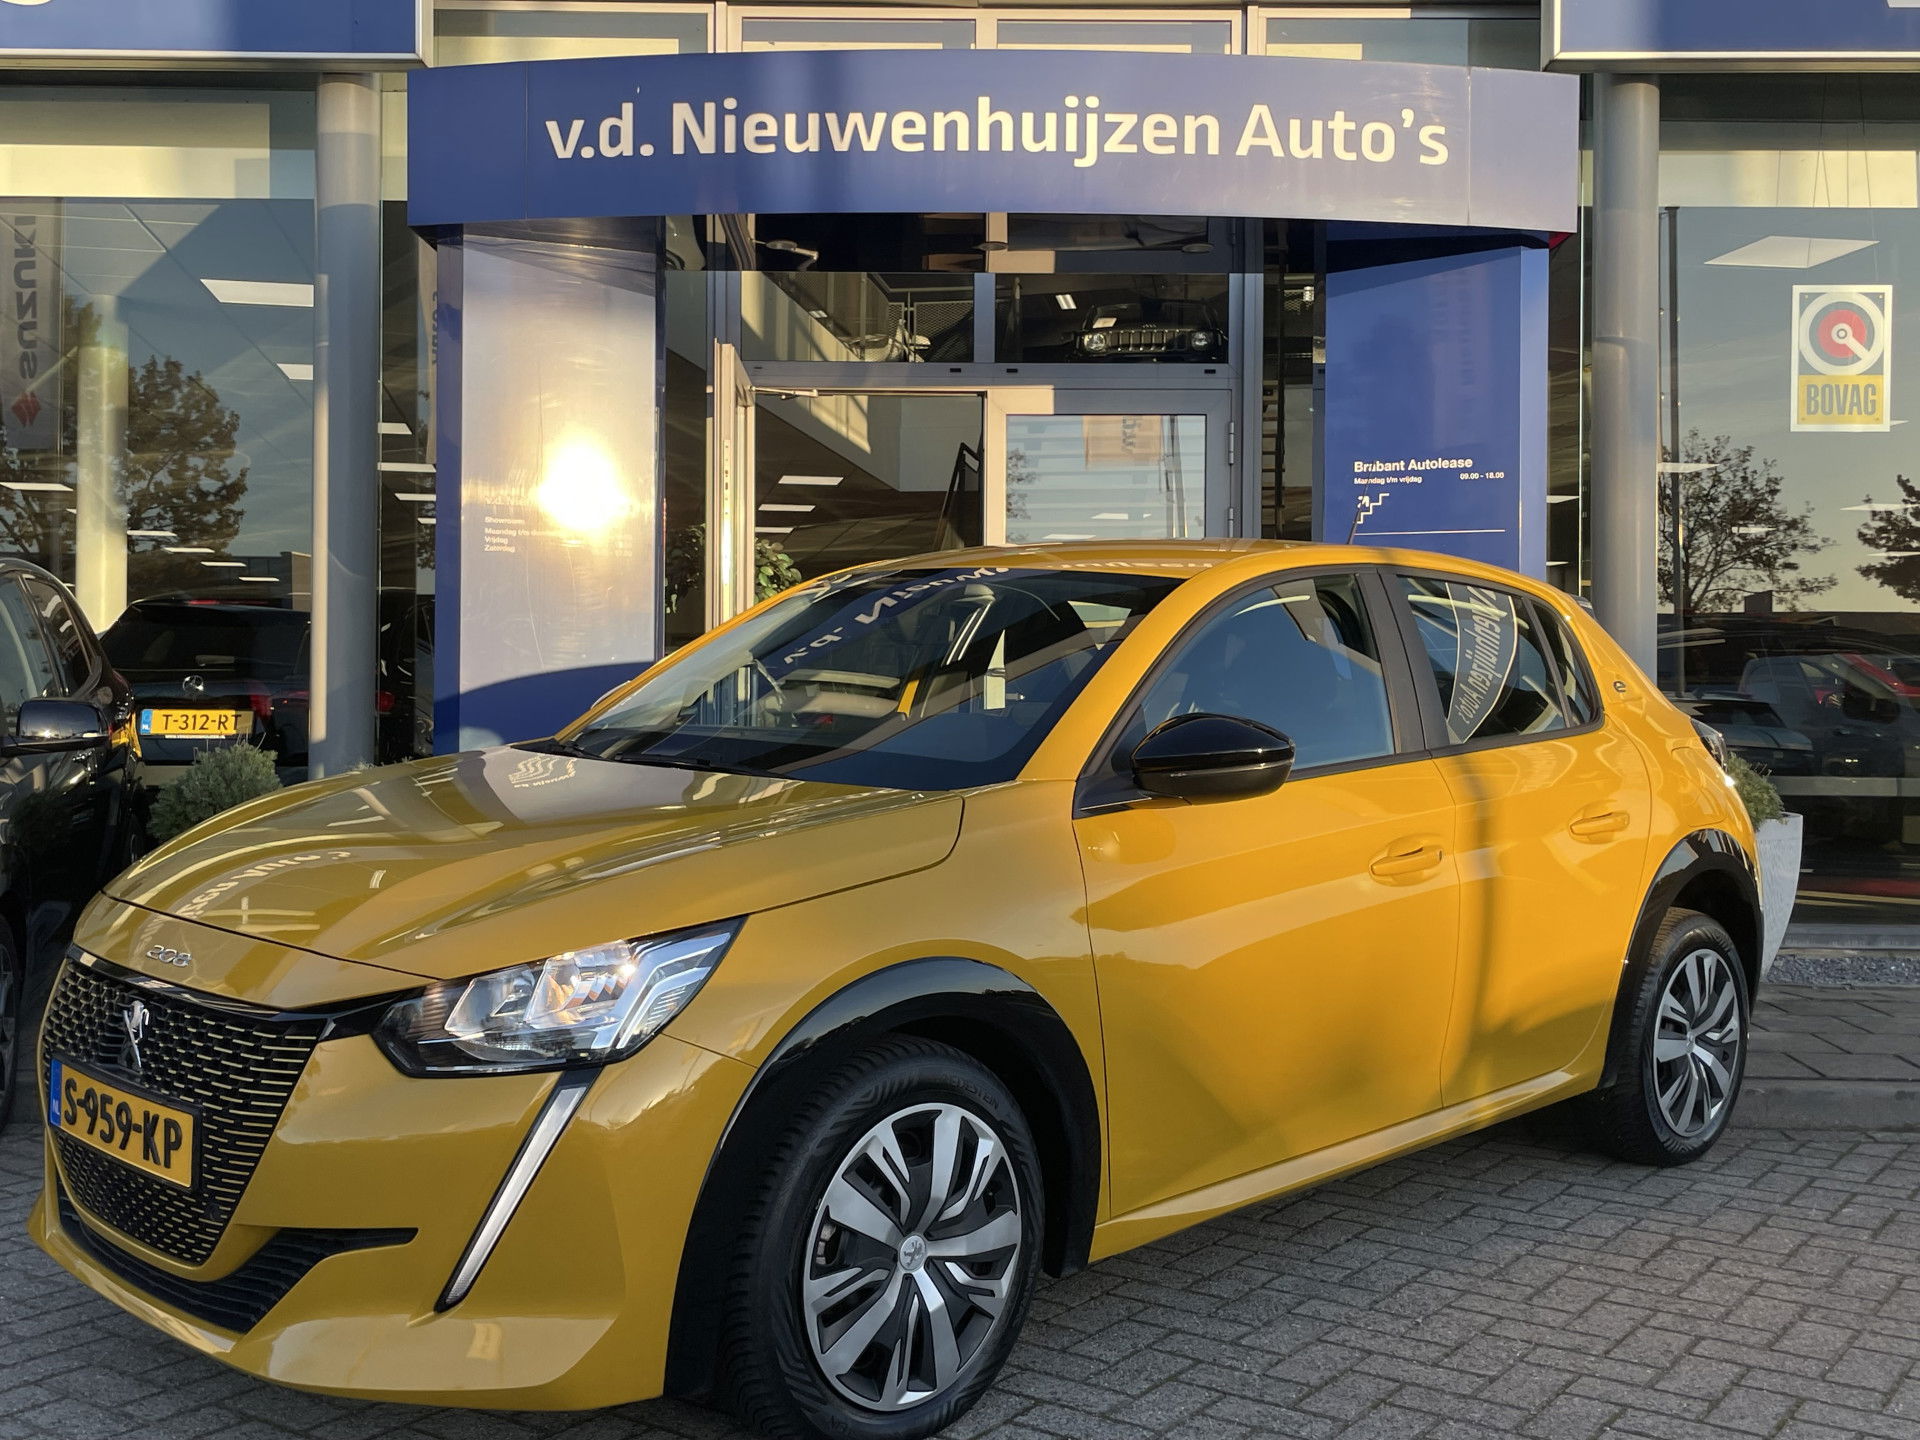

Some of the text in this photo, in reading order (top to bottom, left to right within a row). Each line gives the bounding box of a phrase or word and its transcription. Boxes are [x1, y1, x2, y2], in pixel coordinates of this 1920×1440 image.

[545, 95, 1449, 168] v.d. Nieuwenhuijzen Auto's
[1806, 383, 1876, 416] BOVAG
[1407, 457, 1473, 471] Autolease
[1386, 476, 1398, 484] t/m
[1399, 475, 1422, 484] vrijdag
[1460, 472, 1479, 480] 09.00
[1485, 471, 1505, 479] 18.00
[162, 714, 242, 731] T-312-RT
[146, 944, 192, 967] 208
[64, 1077, 183, 1169] S-959-KP
